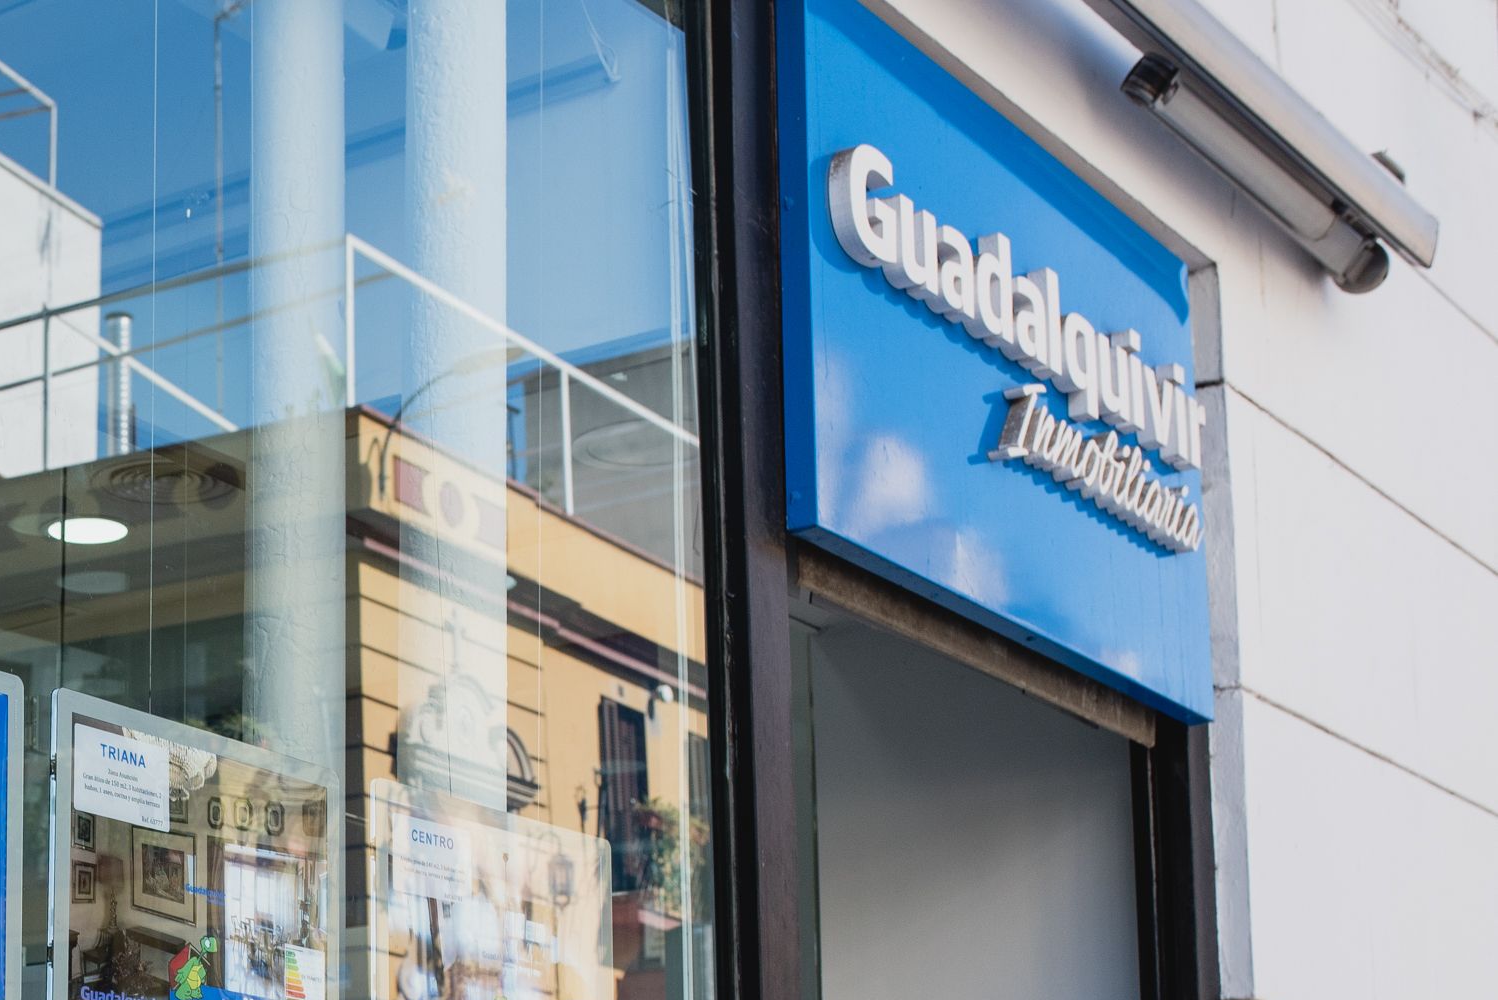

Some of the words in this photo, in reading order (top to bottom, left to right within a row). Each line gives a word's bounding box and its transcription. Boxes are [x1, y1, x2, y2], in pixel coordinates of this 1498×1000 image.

[831, 143, 1206, 470] Guadalquivir
[991, 384, 1202, 553] Inmobiliaria
[100, 743, 146, 769] TRIANA
[105, 777, 111, 786] de
[411, 828, 454, 850] CENTRO
